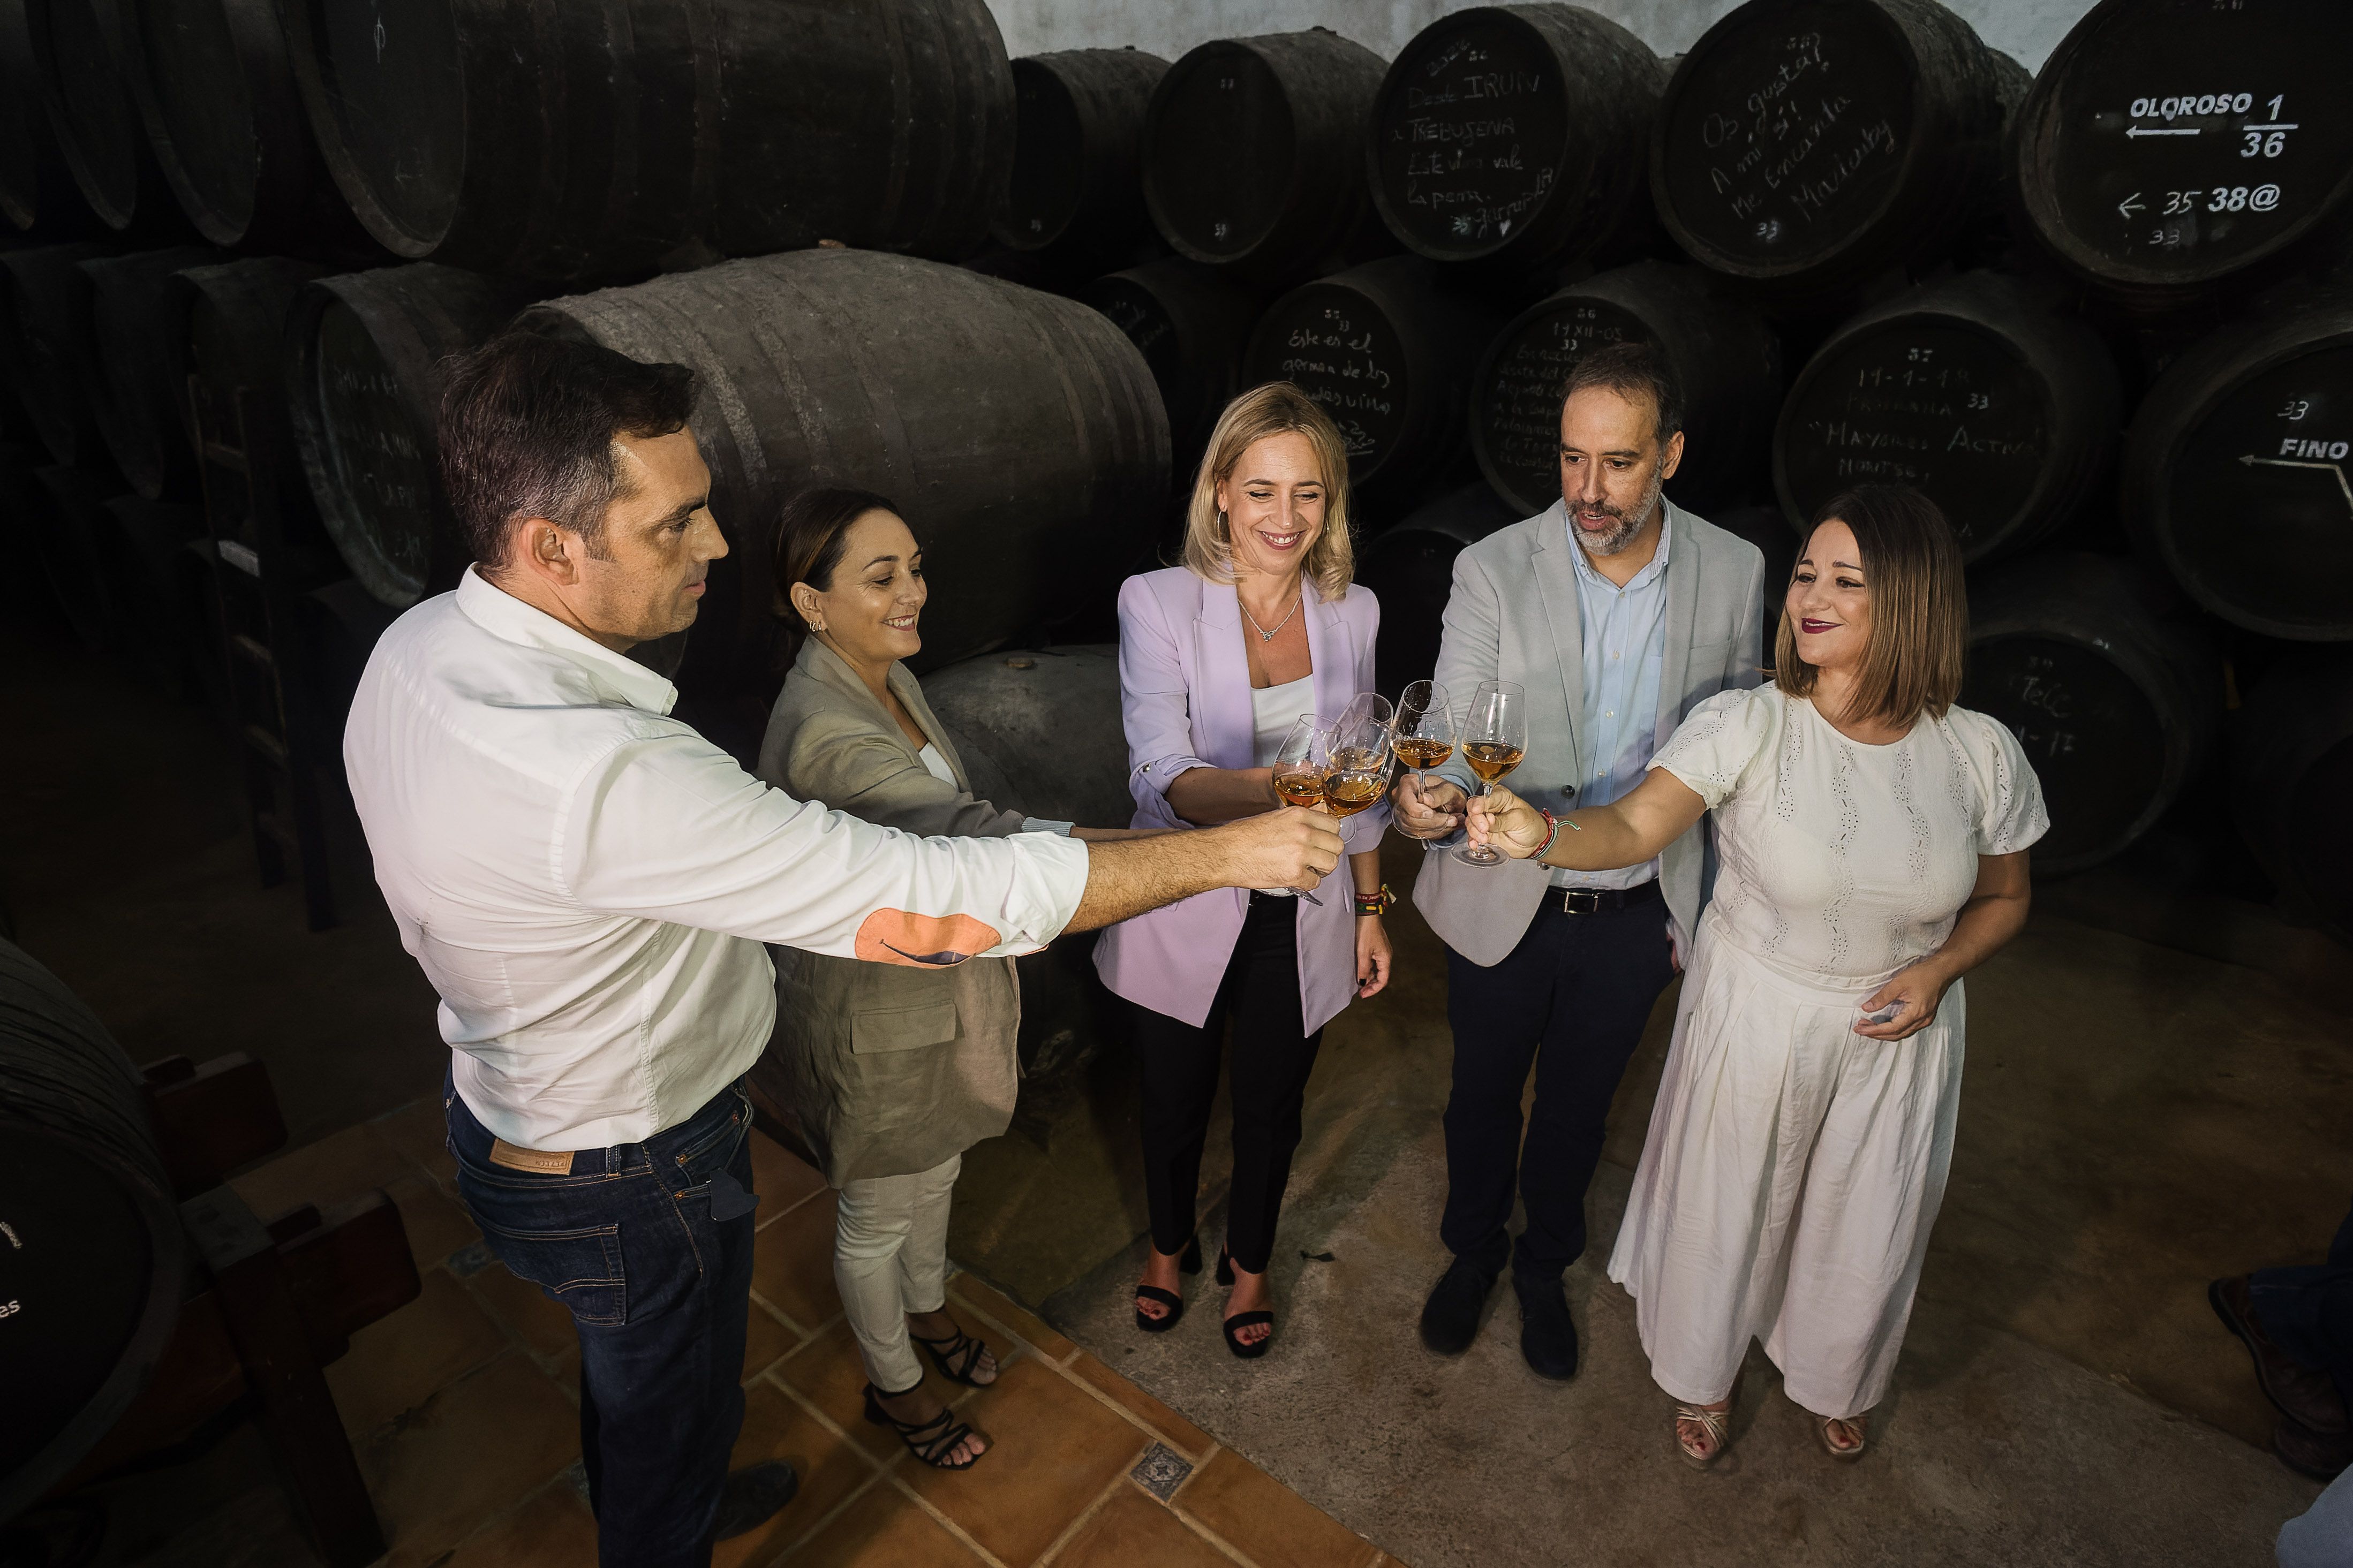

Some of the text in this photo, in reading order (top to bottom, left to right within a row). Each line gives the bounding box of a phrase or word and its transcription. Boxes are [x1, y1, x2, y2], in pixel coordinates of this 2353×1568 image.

[1464, 72, 1540, 99] IRUN
[2129, 93, 2284, 121] OLOROSO 1
[1702, 112, 1739, 148] Os
[1492, 143, 1524, 170] vale
[2240, 132, 2286, 158] 36
[1710, 166, 1732, 195] A
[1731, 193, 1763, 220] Me
[2162, 191, 2202, 216] 35
[1756, 219, 1781, 244] 33
[2148, 229, 2181, 246] 33
[1560, 339, 1579, 351] 33
[1342, 360, 1361, 378] de
[1967, 392, 1989, 410] 33
[2277, 400, 2309, 420] 33
[2280, 437, 2349, 460] FINO
